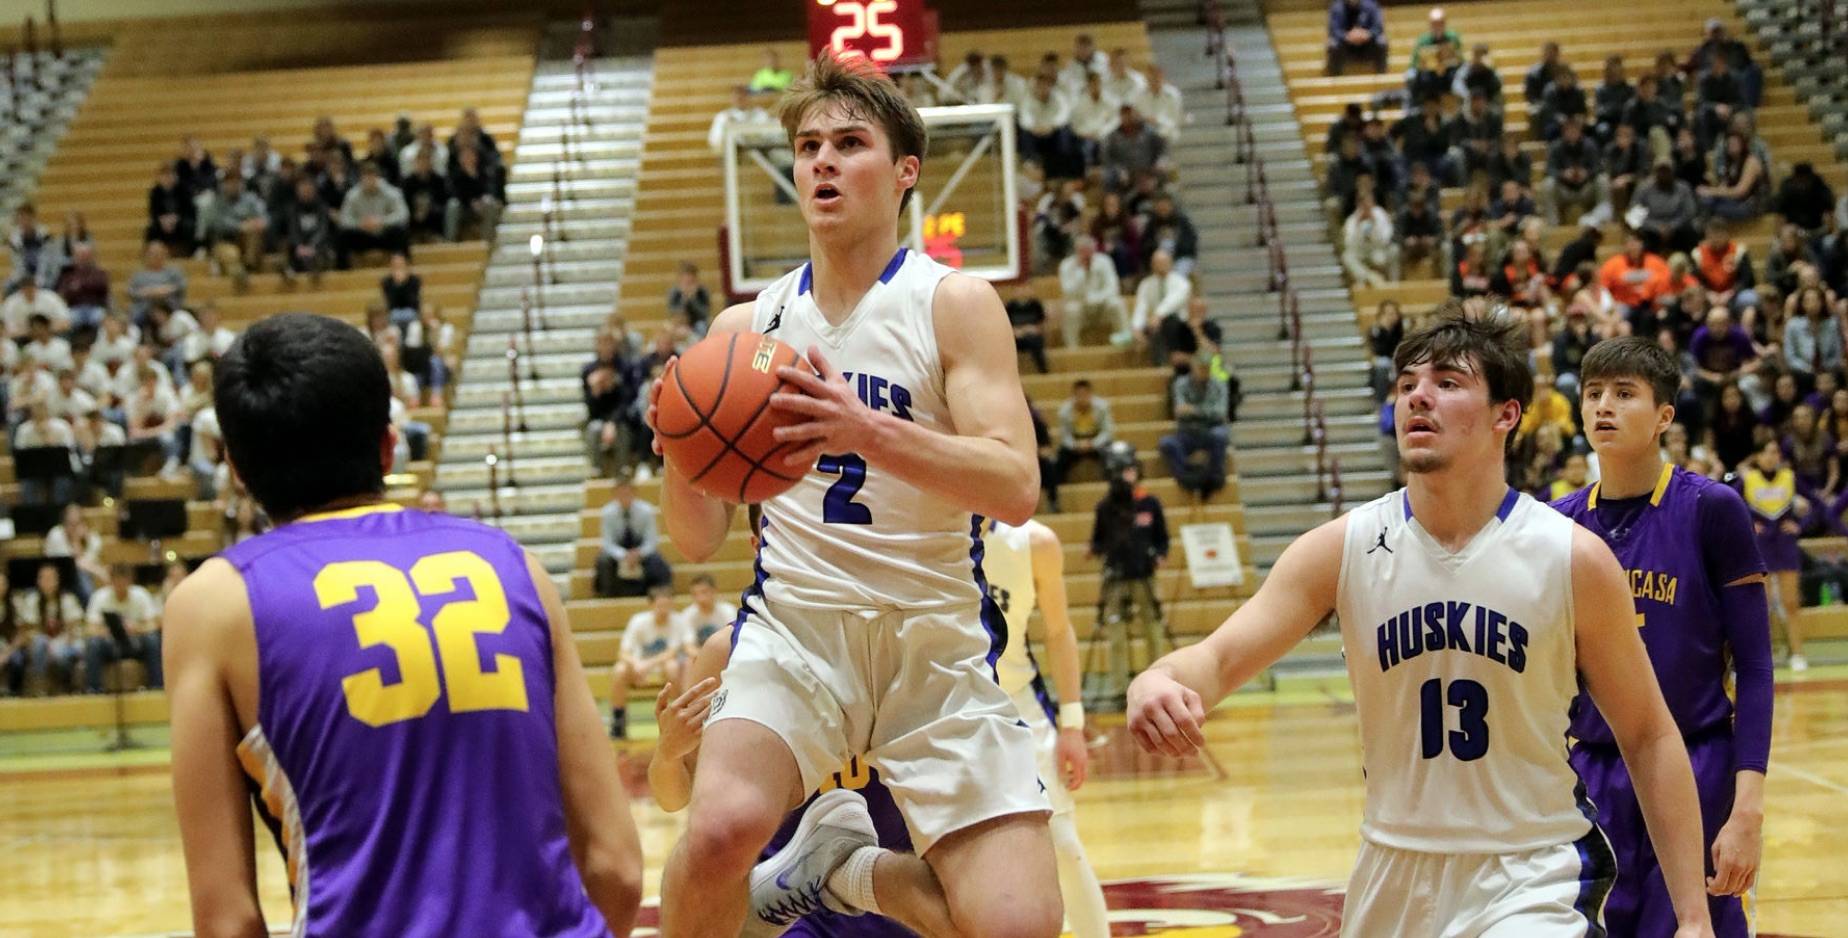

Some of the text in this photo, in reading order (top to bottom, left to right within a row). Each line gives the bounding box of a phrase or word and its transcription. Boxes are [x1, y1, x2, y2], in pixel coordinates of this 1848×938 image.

[831, 0, 904, 61] 25
[816, 452, 873, 525] 2
[1624, 568, 1678, 606] CASA
[313, 550, 529, 728] 32
[1377, 600, 1529, 674] HUSKIES
[1420, 678, 1489, 762] 13
